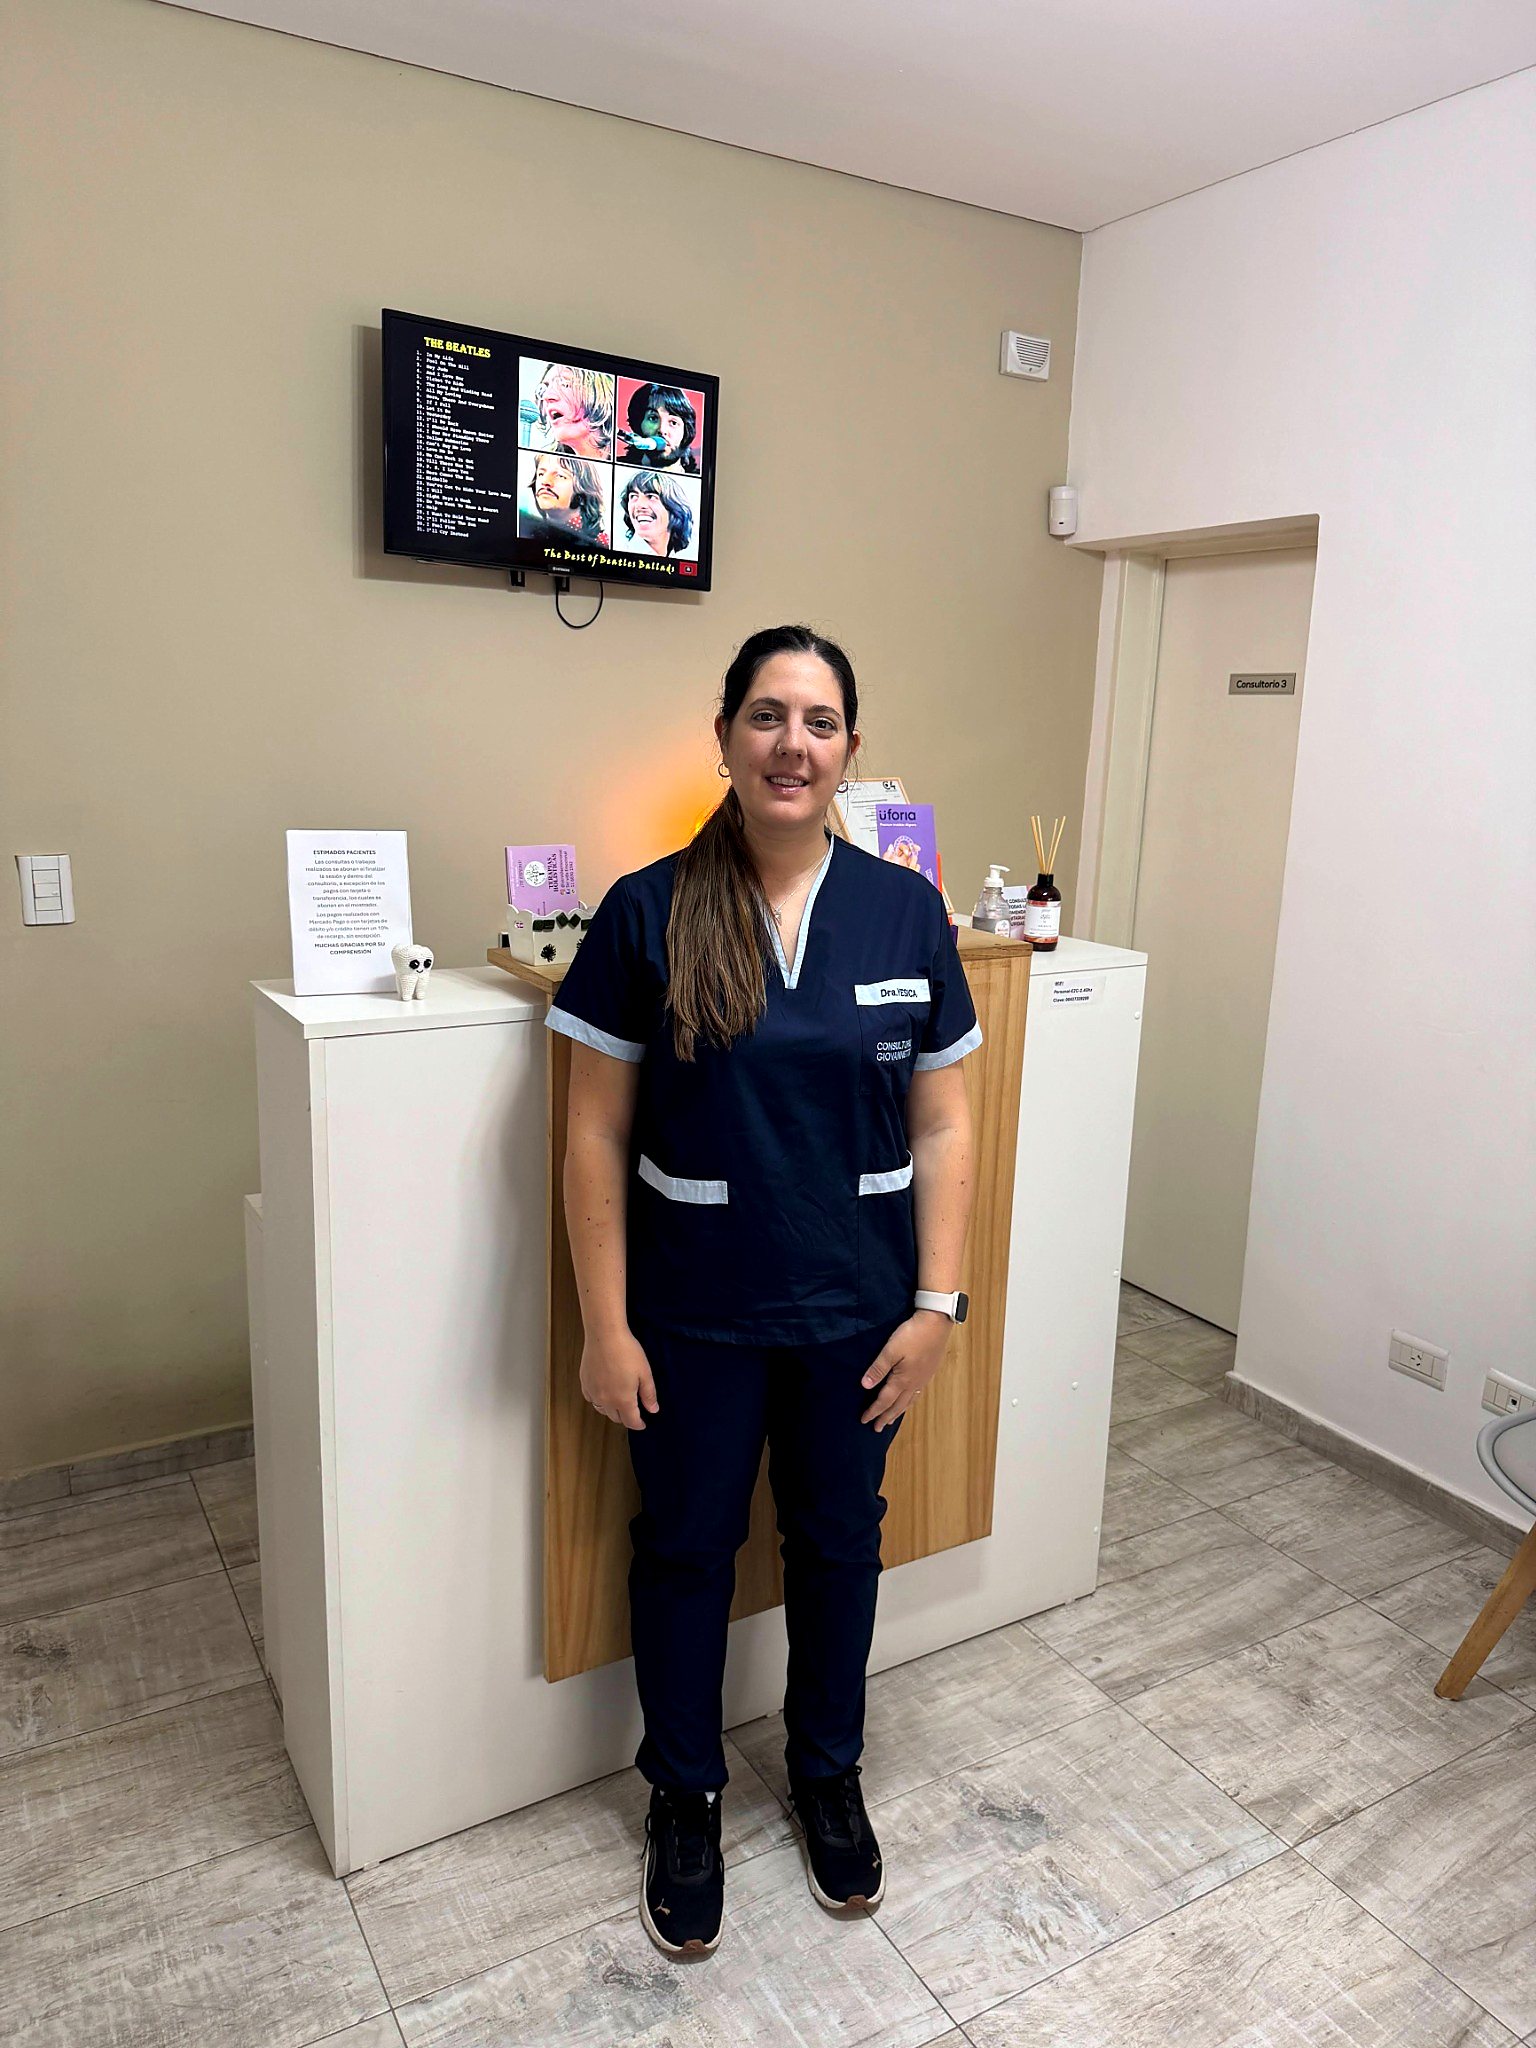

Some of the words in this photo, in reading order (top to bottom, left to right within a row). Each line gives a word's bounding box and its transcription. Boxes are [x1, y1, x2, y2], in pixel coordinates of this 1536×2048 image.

[424, 337, 444, 349] THE
[446, 341, 491, 358] BEATLES
[544, 549, 561, 558] The
[564, 550, 586, 562] Best
[588, 554, 598, 567] Of
[600, 555, 636, 568] Beatles
[638, 560, 675, 574] Ballads
[1236, 680, 1280, 688] Consultorio
[879, 809, 916, 820] üforia
